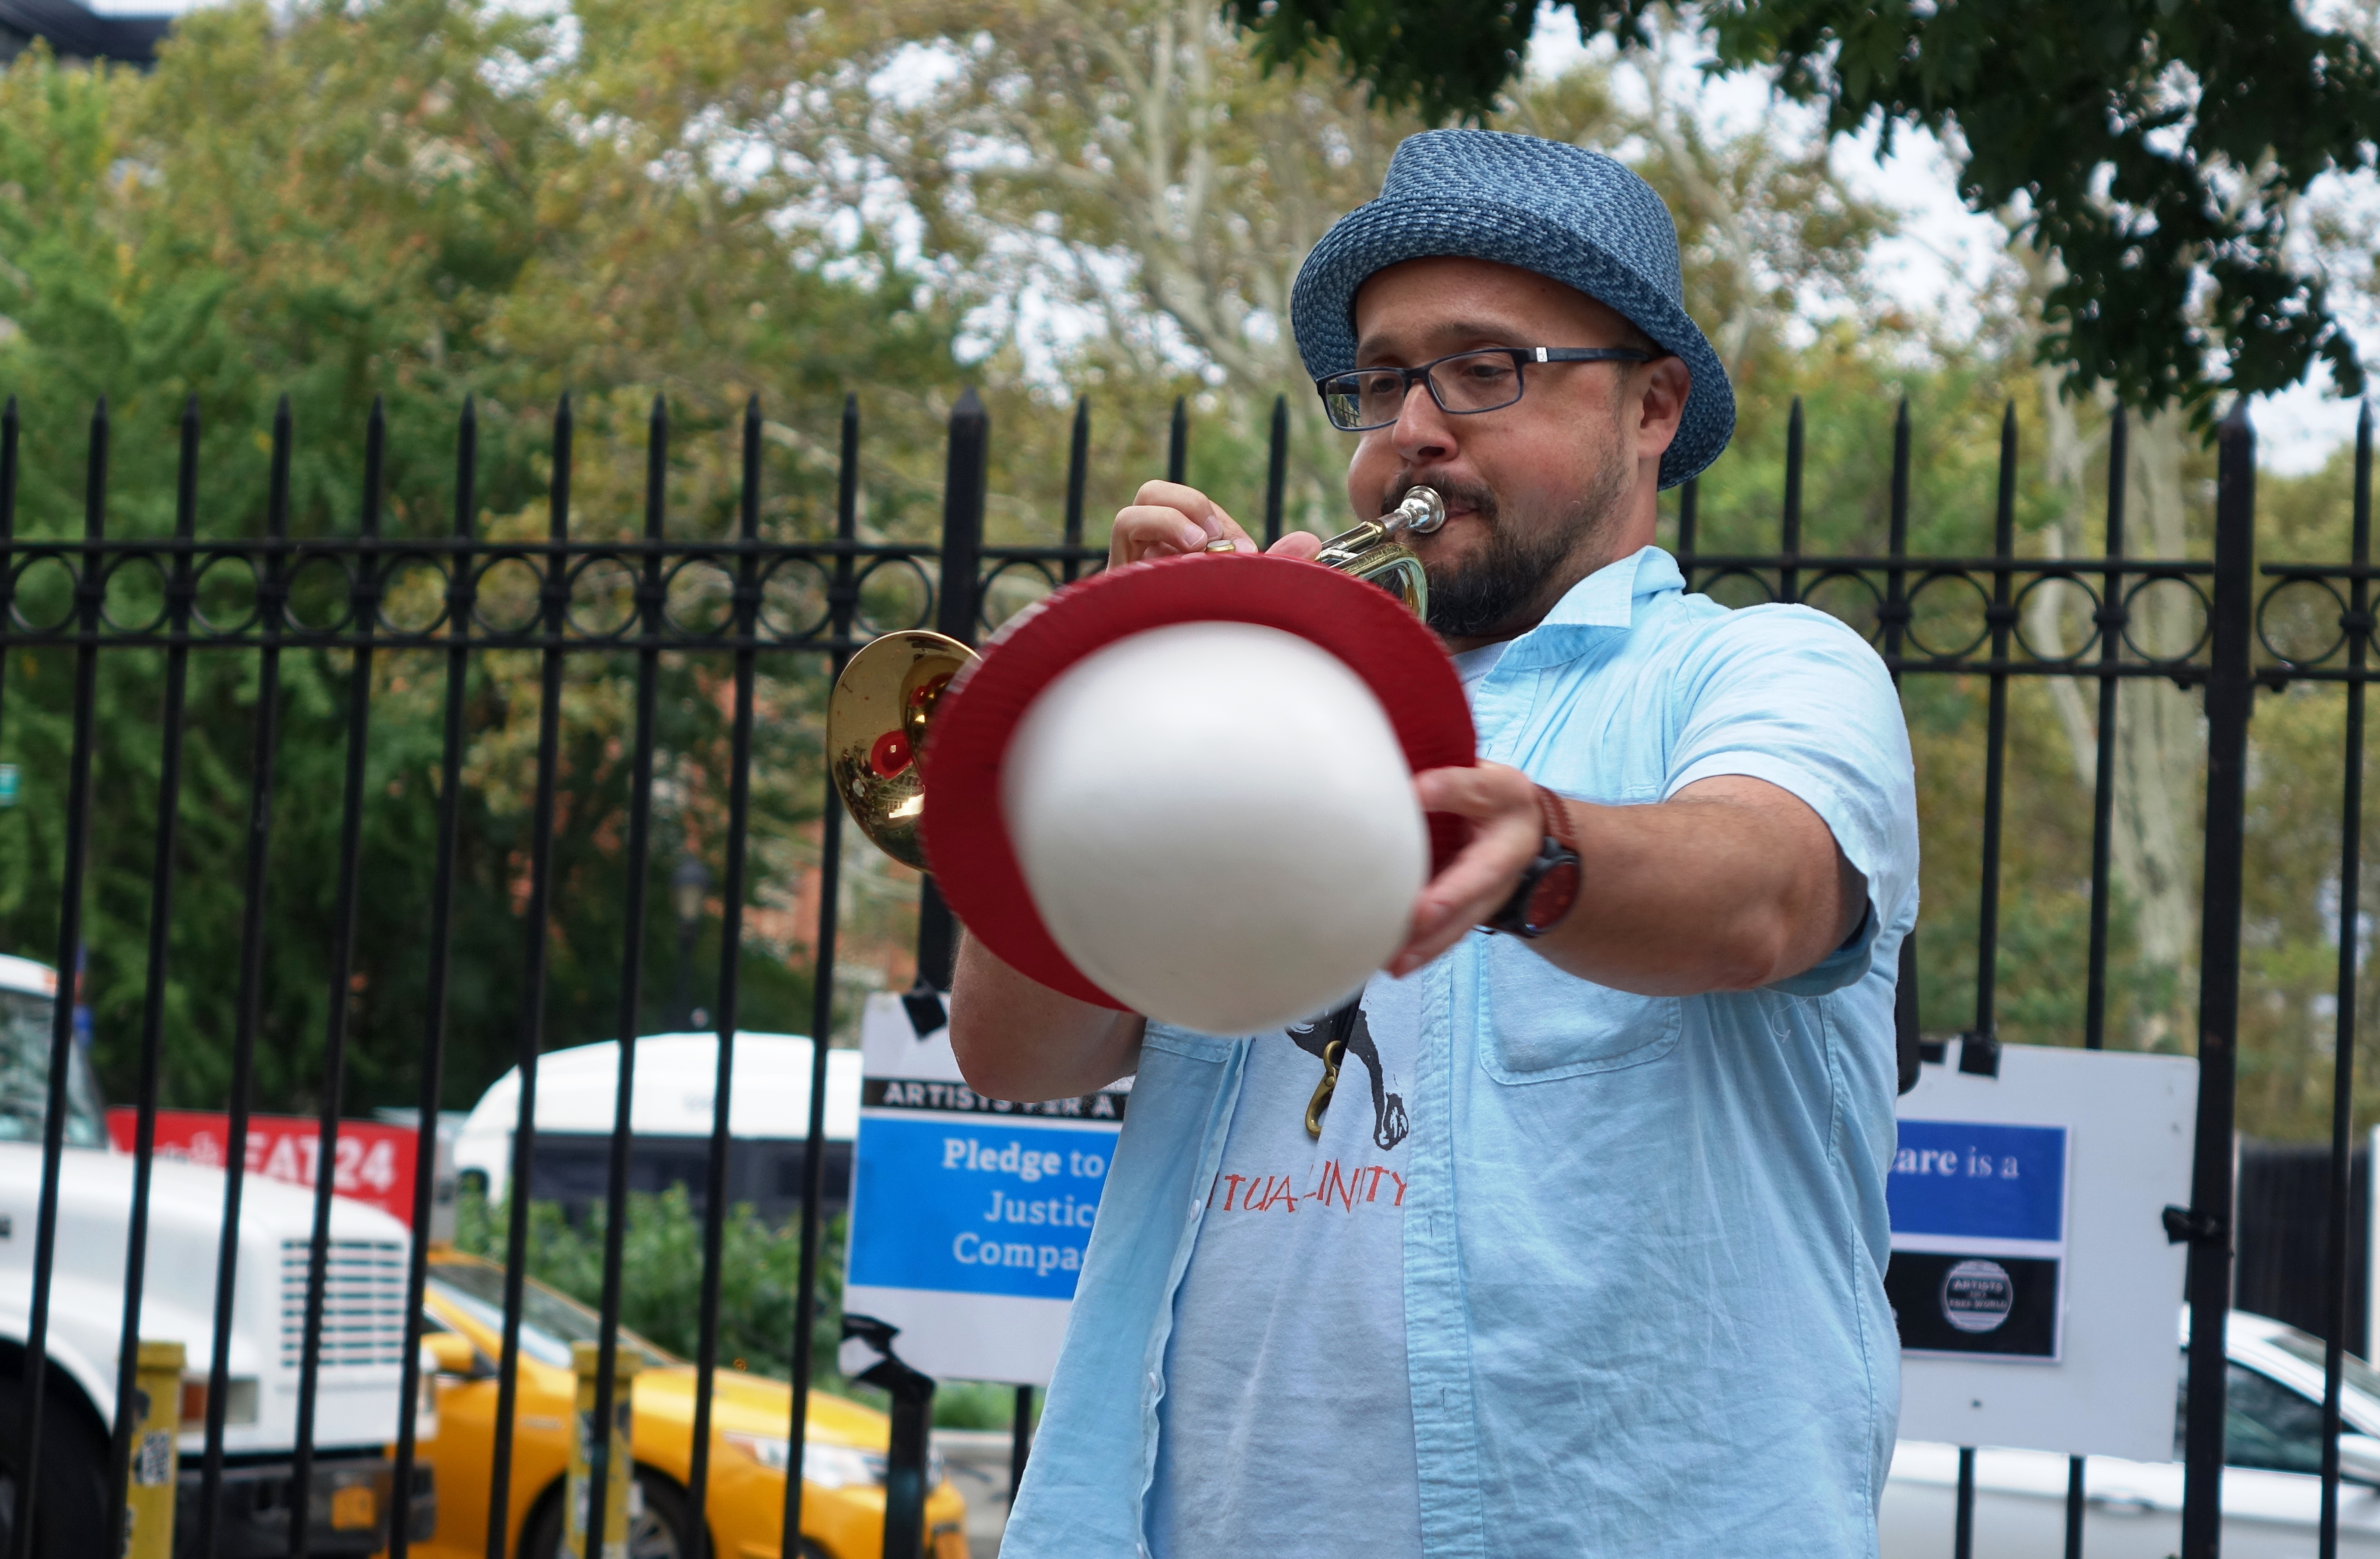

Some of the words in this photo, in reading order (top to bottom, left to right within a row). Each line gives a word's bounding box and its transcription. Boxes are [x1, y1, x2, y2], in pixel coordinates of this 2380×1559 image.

[1091, 1094, 1116, 1118] A
[942, 1138, 1061, 1181] Pledge
[1069, 1150, 1104, 1178] to
[1890, 1147, 1959, 1176] are
[1967, 1145, 1992, 1177] is
[2000, 1155, 2020, 1180] a
[984, 1190, 1098, 1228] Justic
[952, 1232, 1088, 1277] Compa
